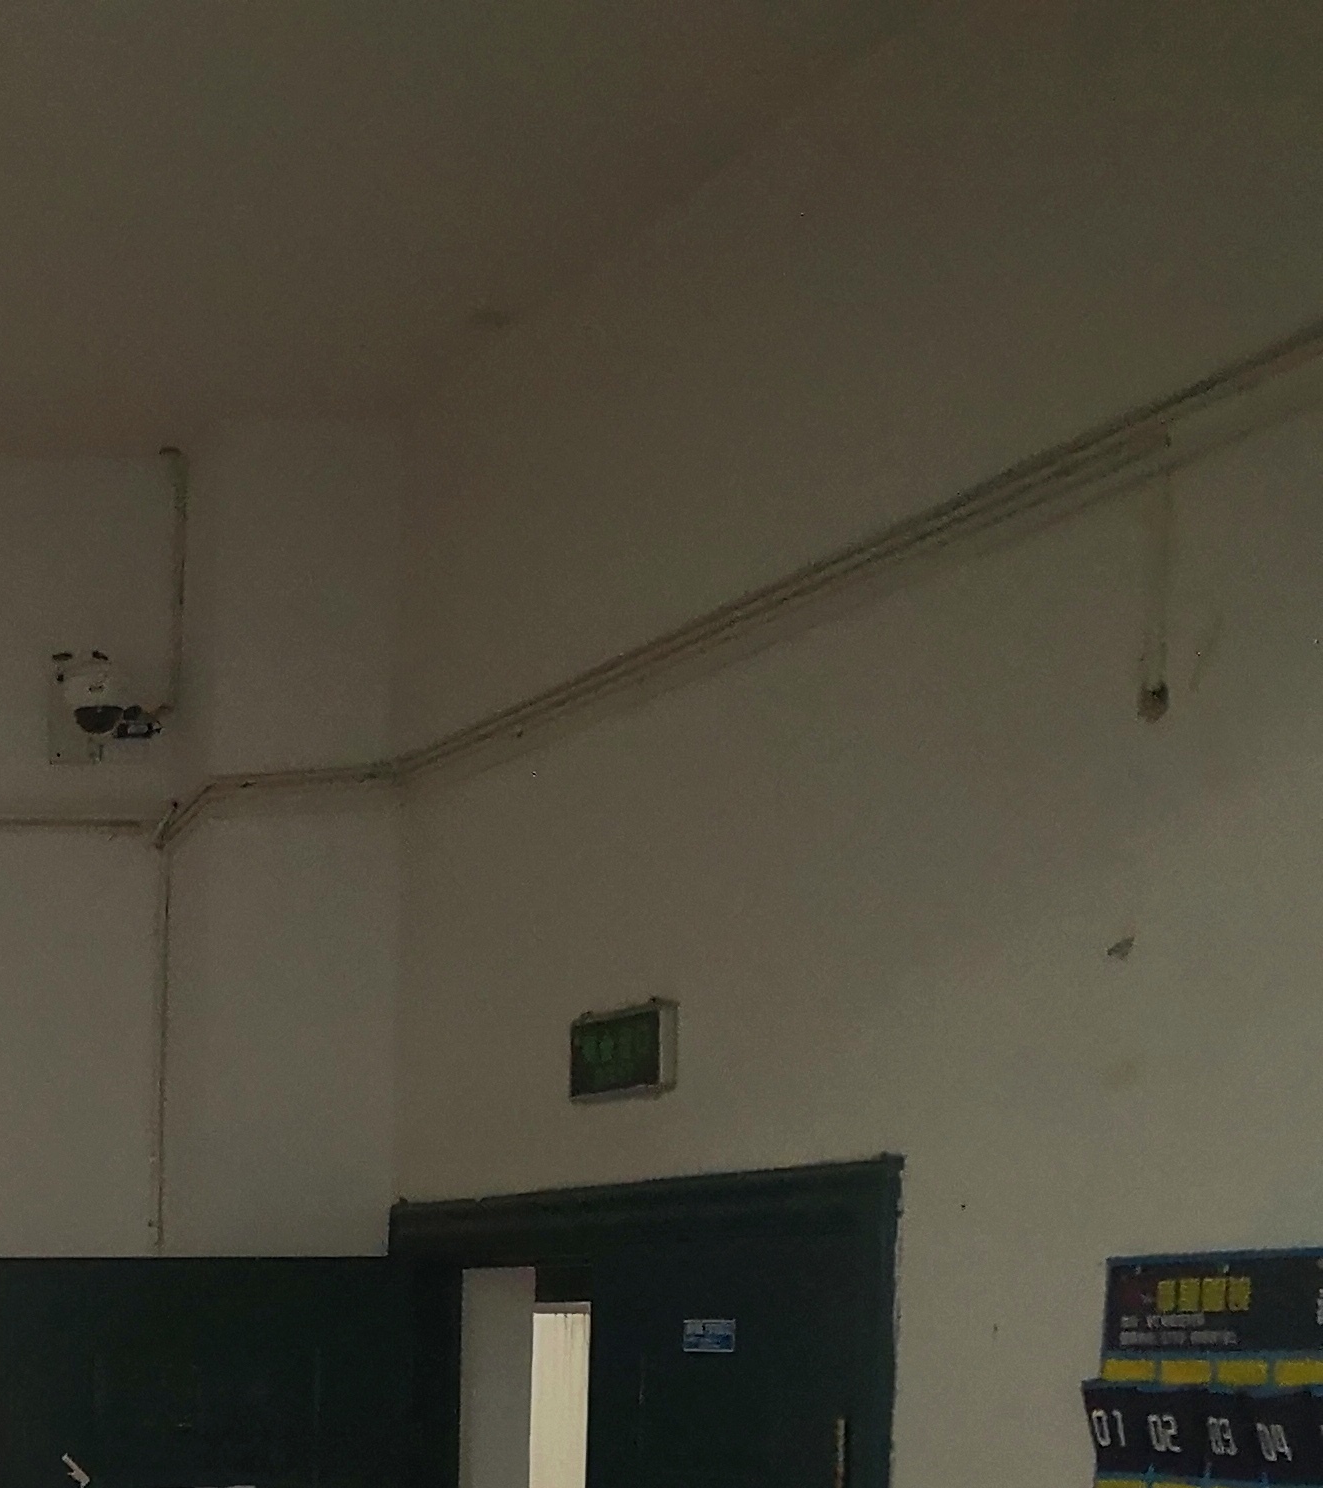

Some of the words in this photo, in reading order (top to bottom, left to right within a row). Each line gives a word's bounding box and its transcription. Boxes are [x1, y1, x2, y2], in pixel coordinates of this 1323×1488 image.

[1092, 1409, 1126, 1447] 01
[1147, 1413, 1183, 1453] 02
[1256, 1422, 1293, 1462] 04
